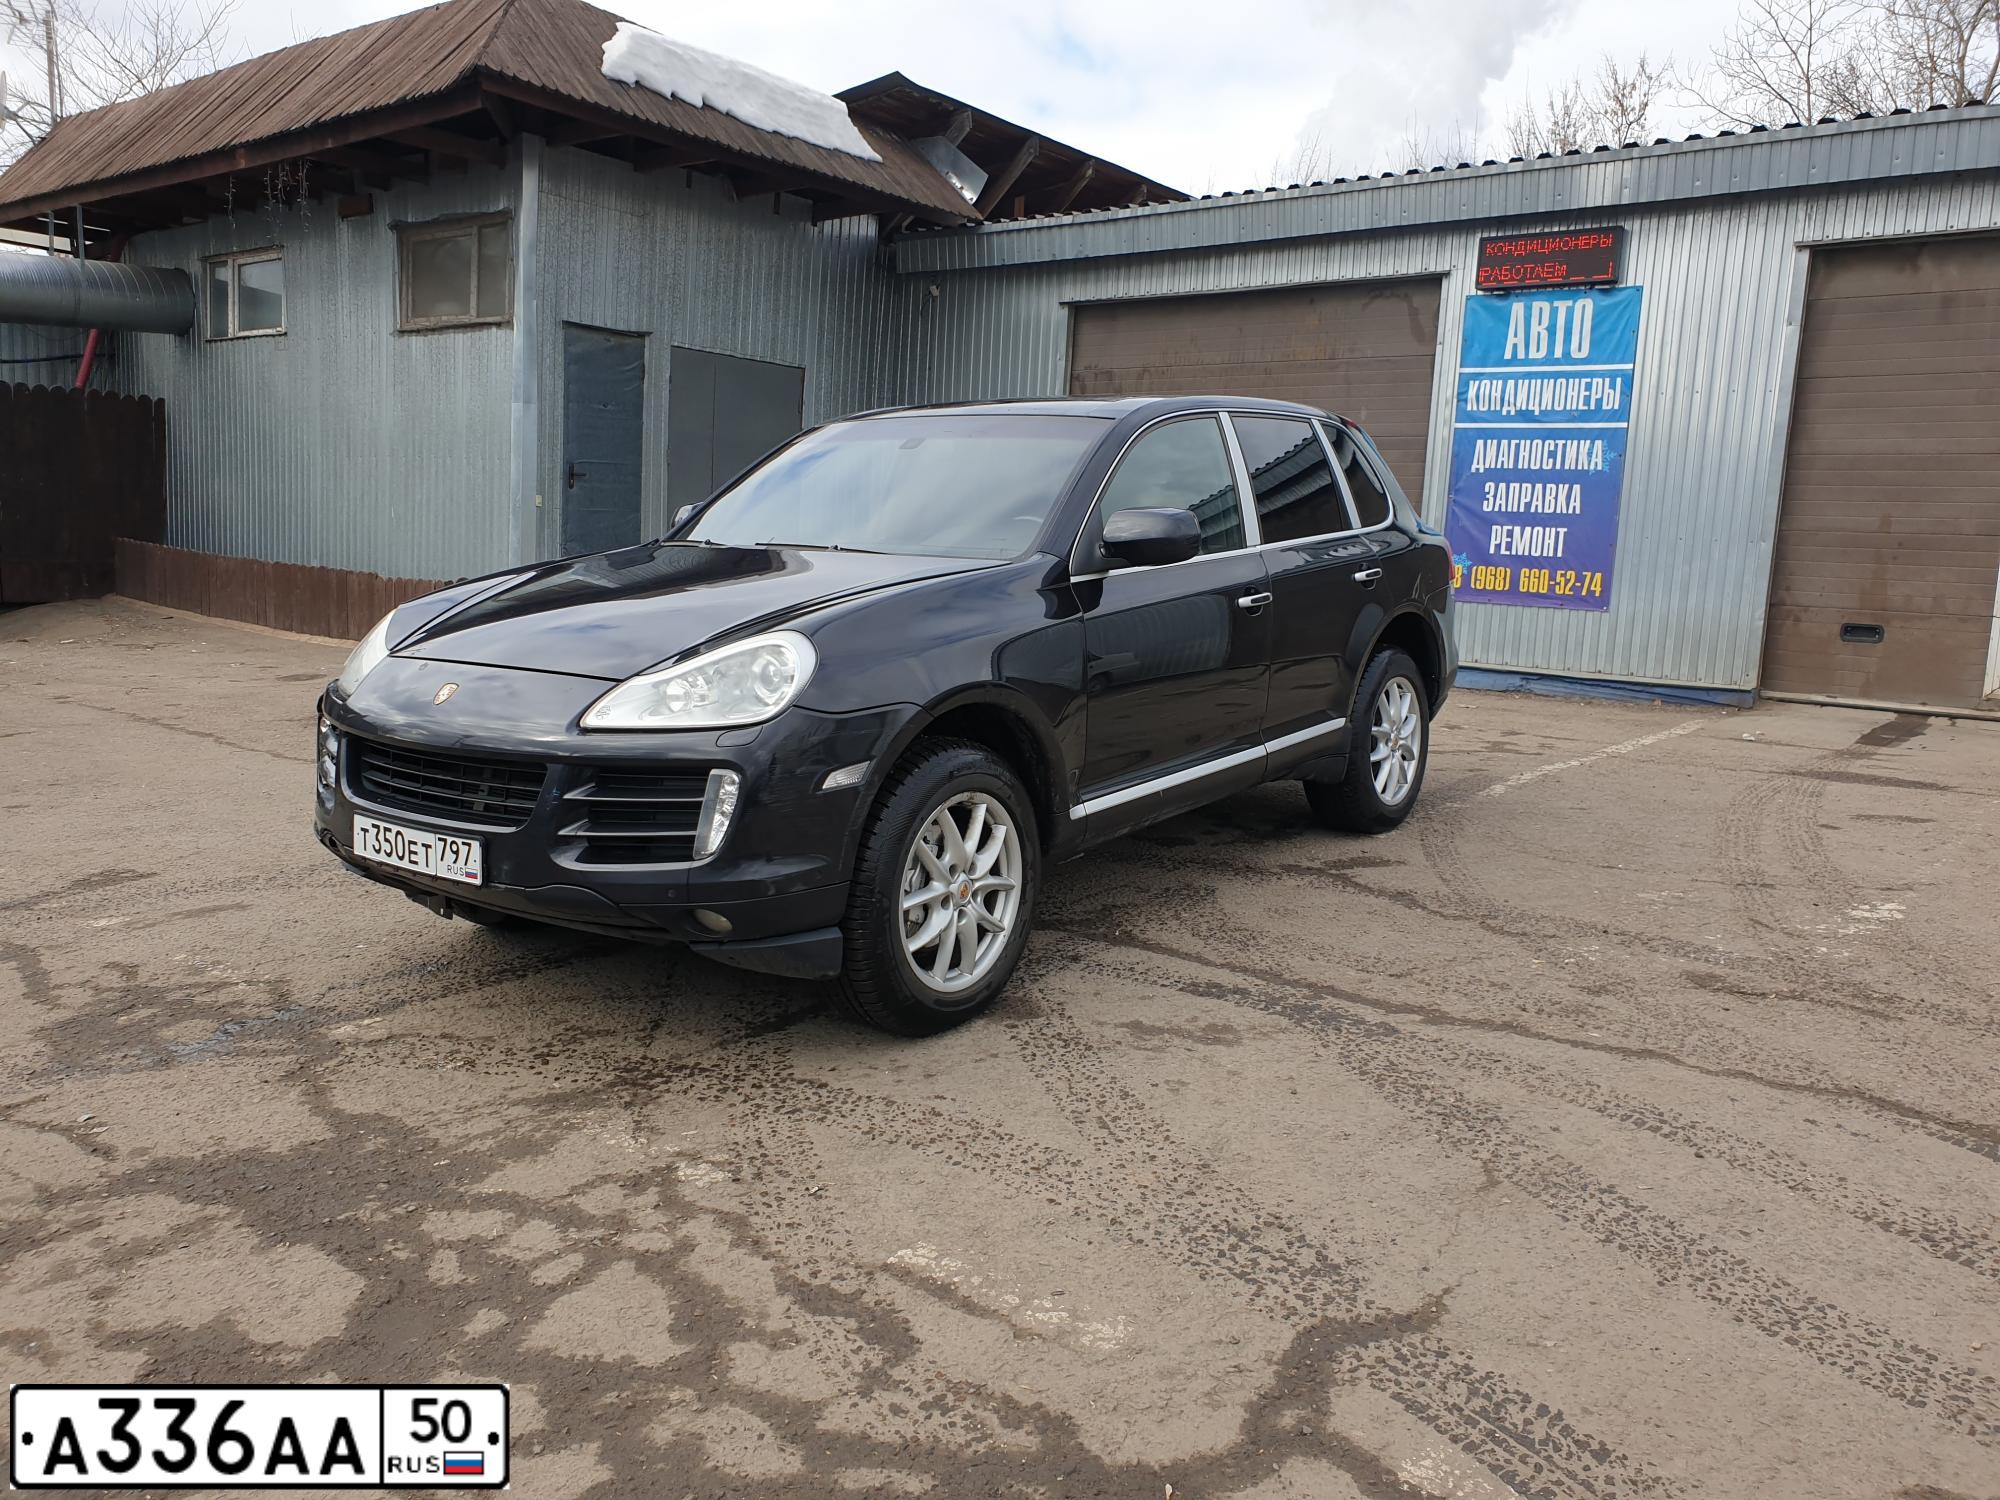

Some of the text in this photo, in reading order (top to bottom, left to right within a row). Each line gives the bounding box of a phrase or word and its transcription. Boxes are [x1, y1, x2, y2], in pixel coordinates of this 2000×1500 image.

[1486, 234, 1613, 256] КОНДИЦИОНЕРЫ
[1504, 298, 1594, 360] АВТО
[1467, 377, 1622, 416] КОНДИЦИОНЕРЫ
[1471, 439, 1603, 473] ДИАГНОСТИКА
[1483, 482, 1581, 514] ЗАПРАВКА
[1489, 525, 1567, 557] РЕМОНТ
[1470, 566, 1511, 591] (968)
[1519, 568, 1602, 597] 660-52-74
[360, 822, 472, 868] Т350ЕТ 797
[447, 864, 464, 877] RUS
